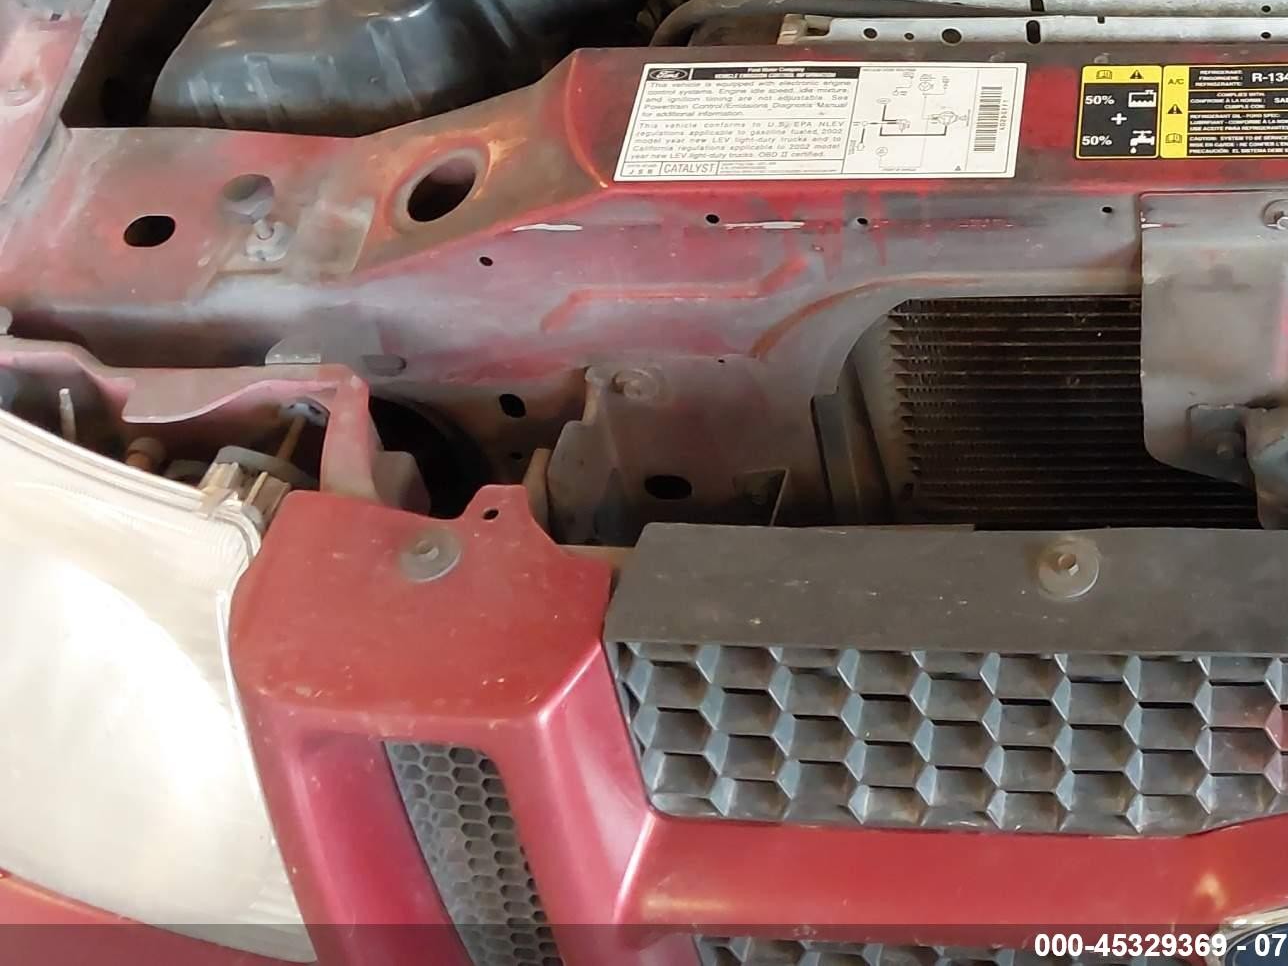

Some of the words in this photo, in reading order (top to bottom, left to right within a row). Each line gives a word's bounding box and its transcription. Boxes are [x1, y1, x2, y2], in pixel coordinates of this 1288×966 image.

[1085, 96, 1115, 105] 50%
[1082, 136, 1112, 146] 50%
[662, 163, 715, 173] CATALYST
